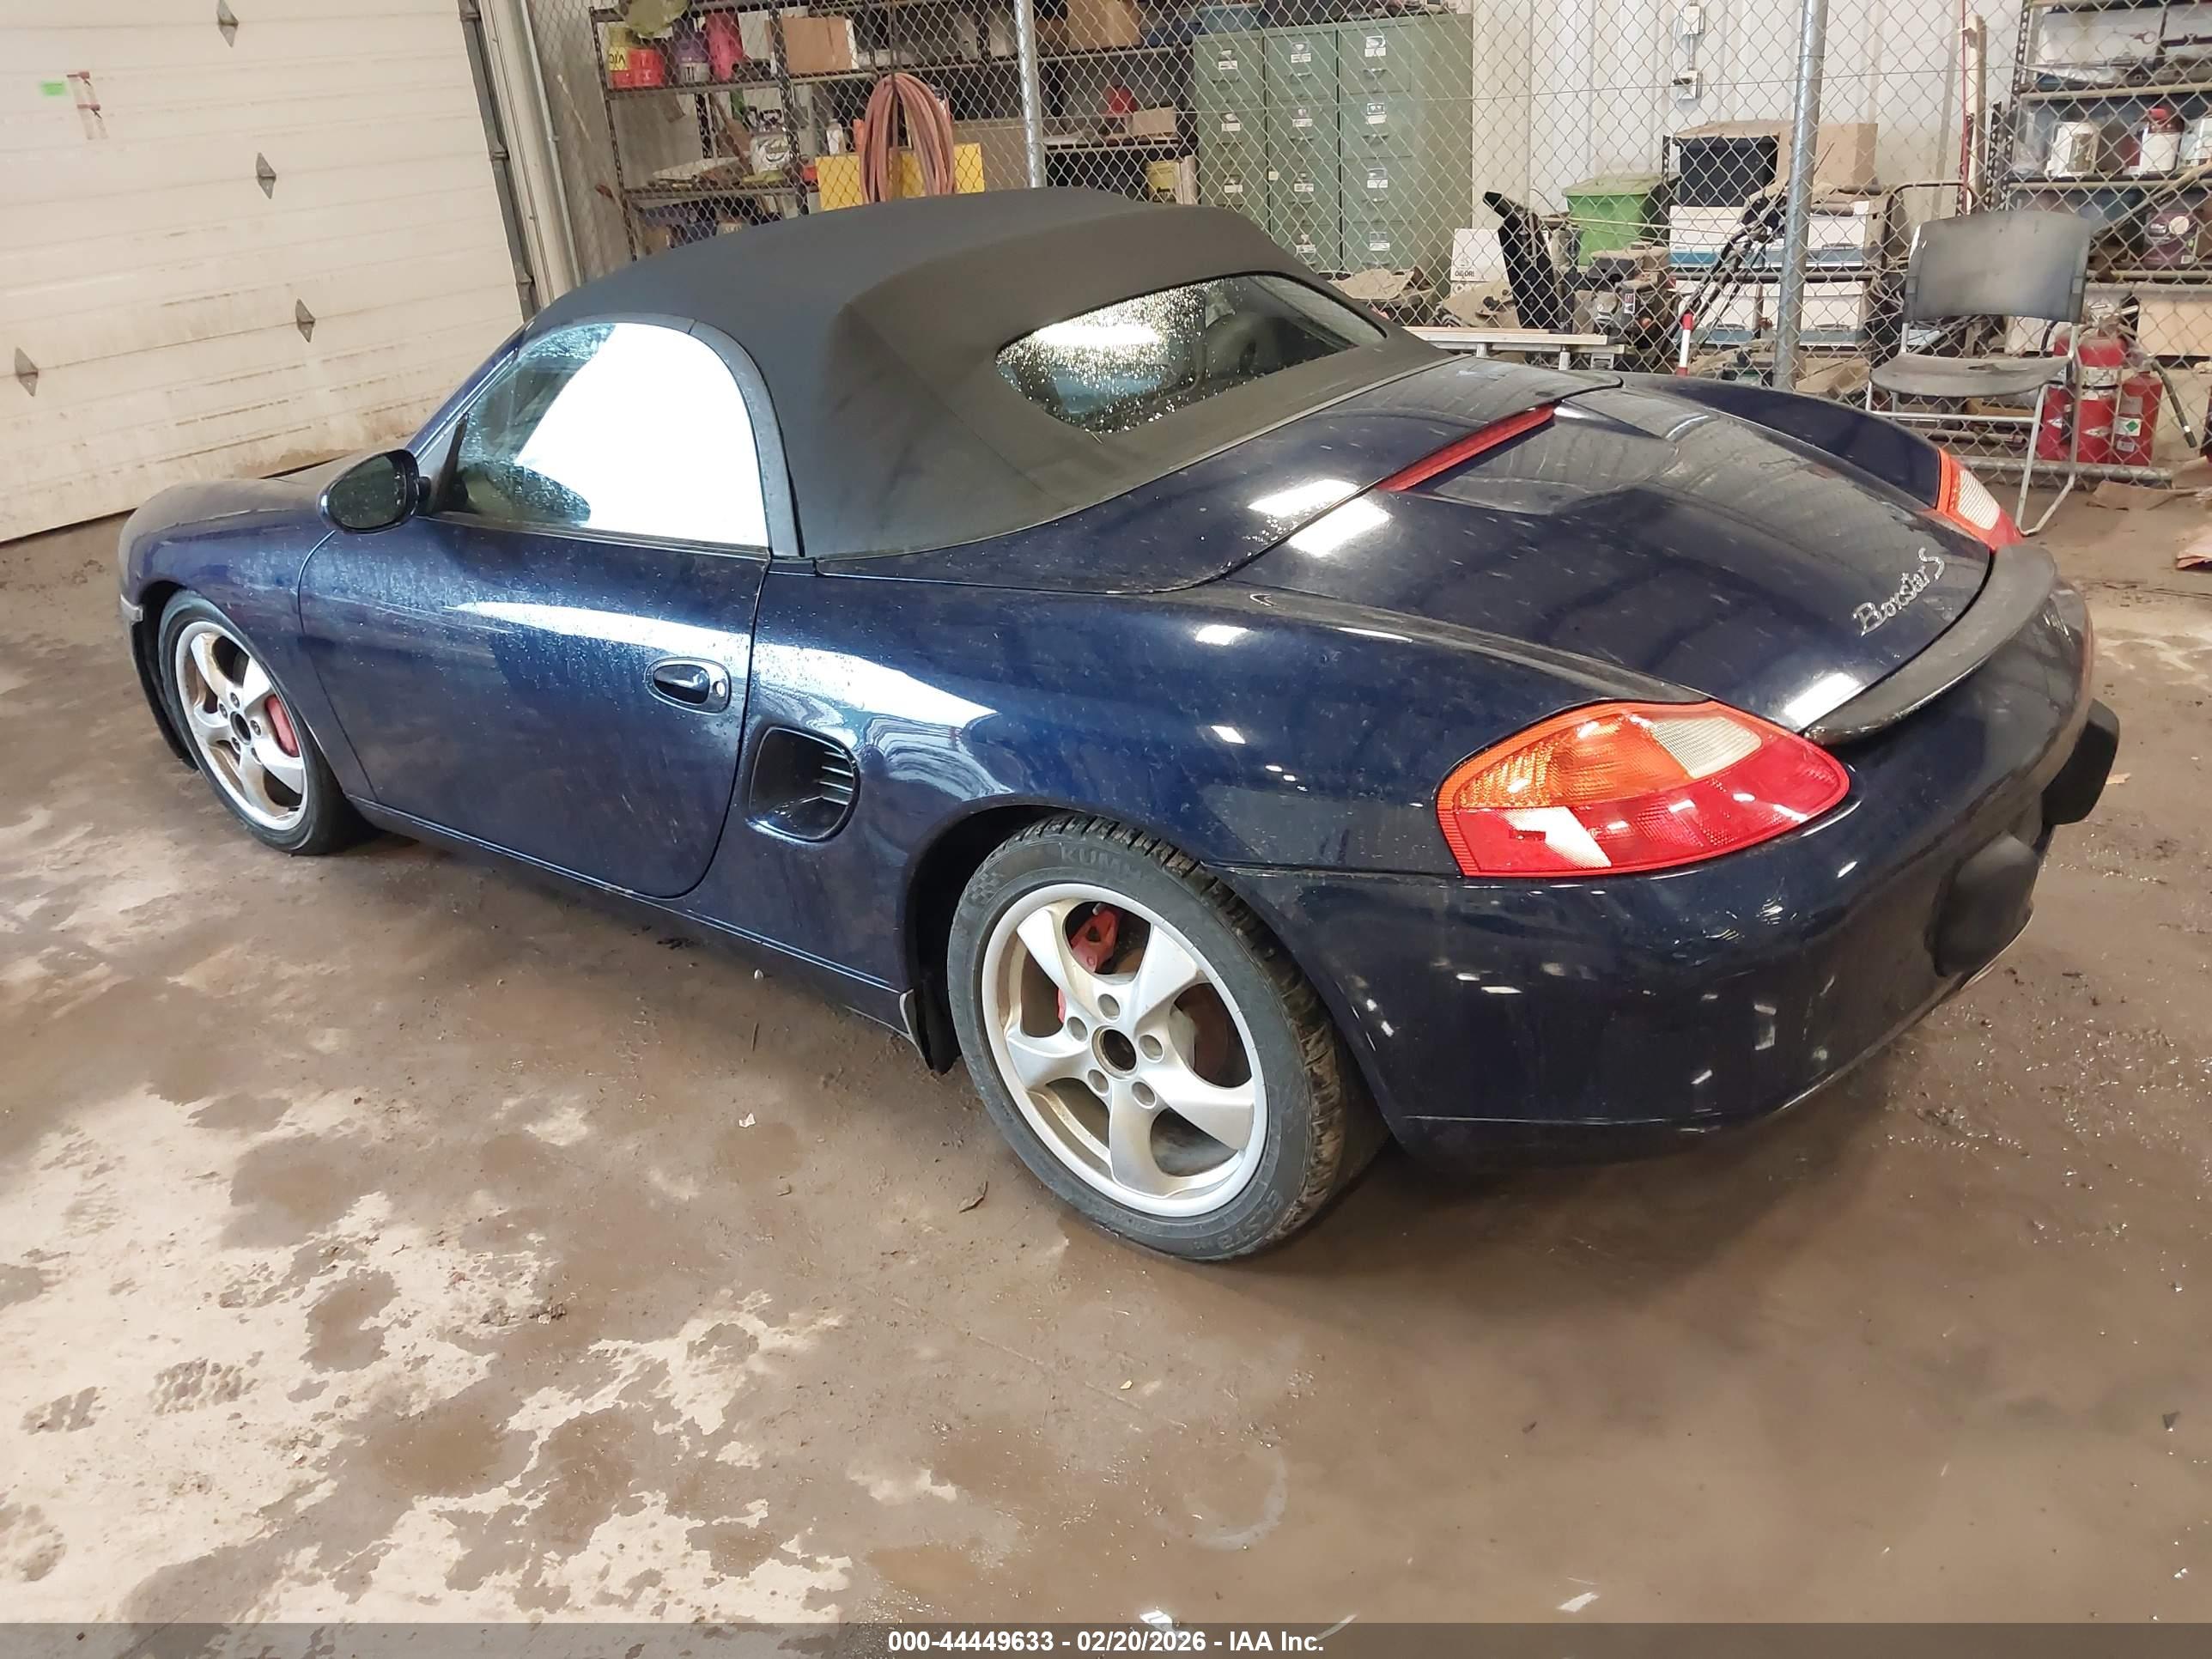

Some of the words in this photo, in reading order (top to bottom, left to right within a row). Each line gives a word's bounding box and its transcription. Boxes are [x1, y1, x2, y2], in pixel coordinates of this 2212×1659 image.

[1853, 565, 1931, 637] Boxster
[1917, 547, 1946, 580] S
[1059, 844, 1144, 883] KUMH
